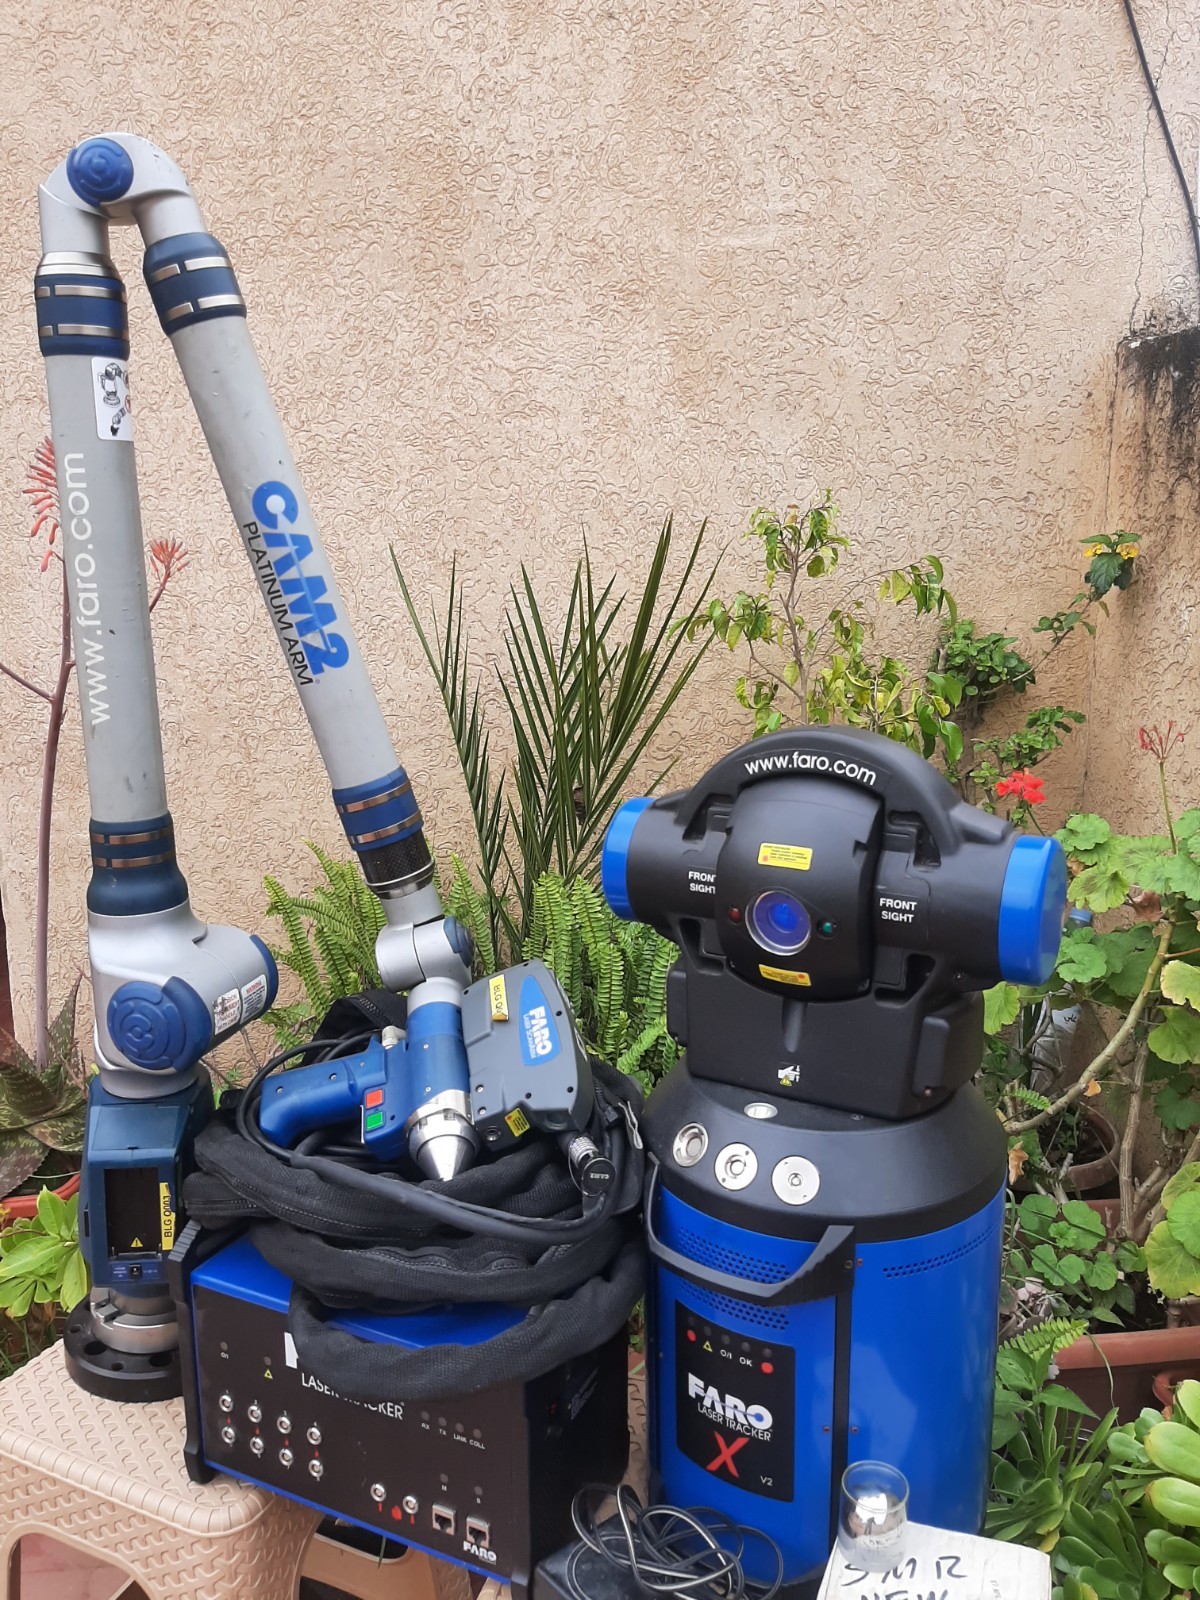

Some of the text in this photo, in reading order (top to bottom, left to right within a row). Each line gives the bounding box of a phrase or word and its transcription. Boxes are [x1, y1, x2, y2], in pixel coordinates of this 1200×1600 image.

[64, 452, 111, 725] www.faro.com
[251, 480, 350, 676] CAM2
[242, 520, 314, 686] PLATINUM ARM
[744, 751, 877, 786] www.faro.com
[688, 870, 717, 883] FRON
[879, 897, 918, 911] FRONT
[881, 910, 914, 923] SIGHT
[528, 1005, 553, 1056] FARO
[164, 1219, 172, 1238] BLG
[739, 1356, 753, 1367] OK
[688, 1372, 773, 1431] FARO
[697, 1402, 772, 1442] LASER TRACKER
[706, 1430, 750, 1479] X
[760, 1475, 773, 1487] V2
[463, 1540, 497, 1561] FARO
